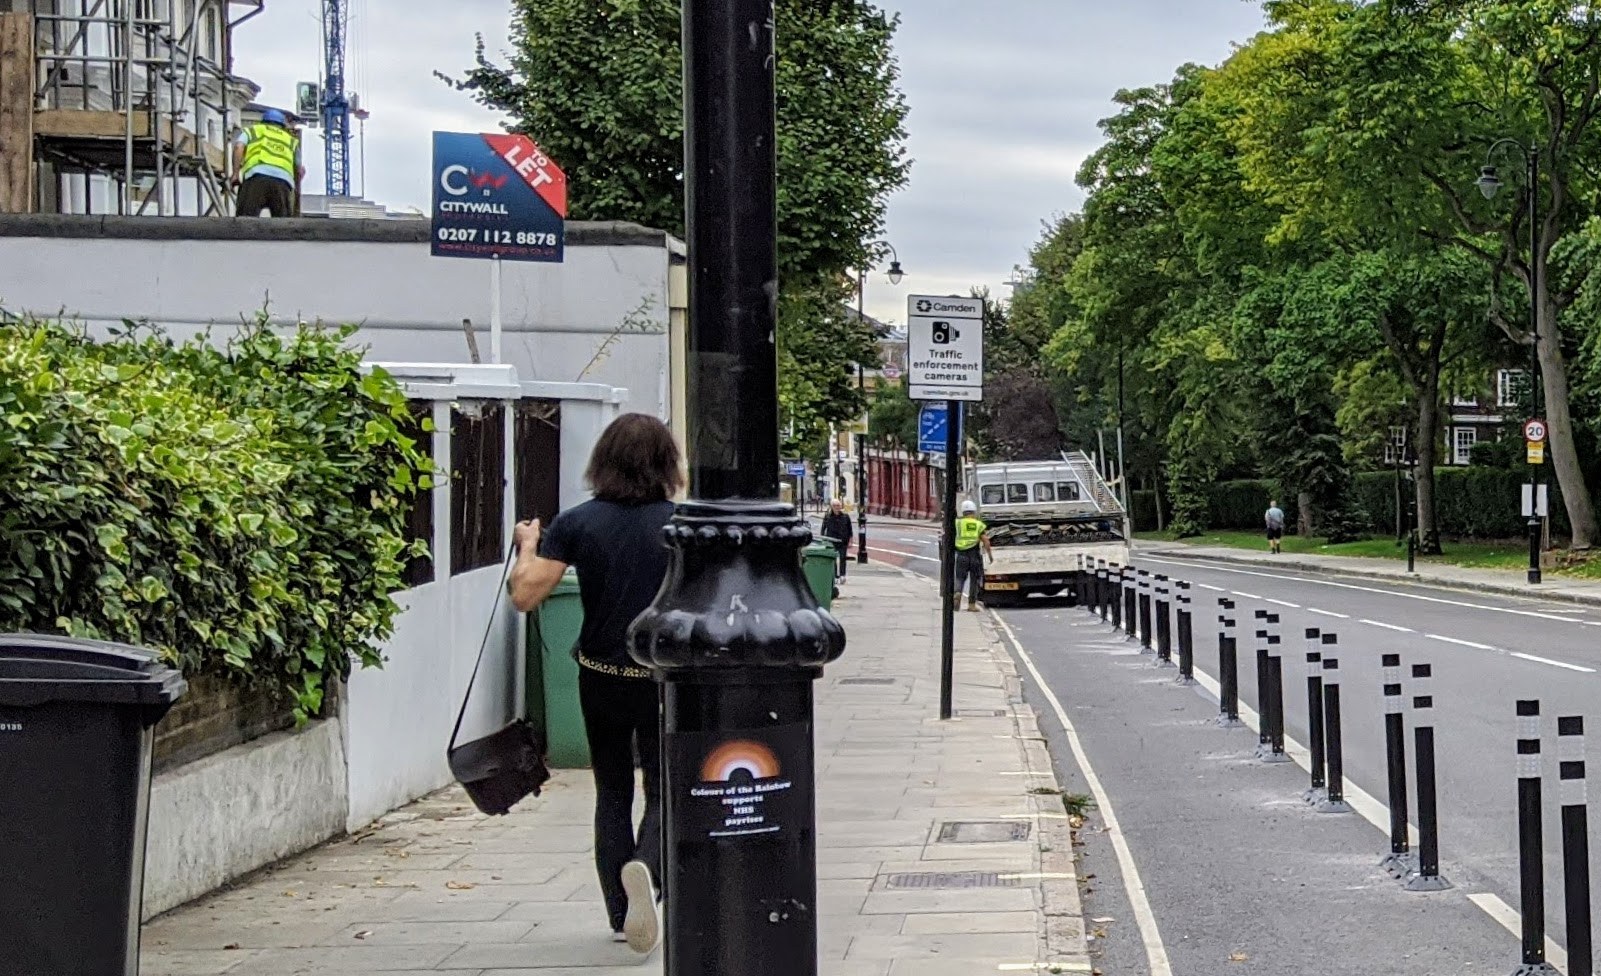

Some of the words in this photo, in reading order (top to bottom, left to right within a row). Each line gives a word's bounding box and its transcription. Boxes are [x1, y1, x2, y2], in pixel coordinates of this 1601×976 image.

[531, 149, 547, 167] TO
[504, 145, 553, 188] LET
[440, 201, 508, 214] CITYWALL
[438, 227, 477, 241] 0207
[484, 230, 511, 244] 112
[516, 231, 556, 246] 8878
[933, 302, 976, 313] Camden
[929, 349, 963, 360] Traffic
[913, 360, 979, 371] enforcement
[924, 373, 968, 381] cameras
[1528, 427, 1543, 436] 20
[691, 788, 724, 796] Colours
[725, 786, 736, 794] of
[737, 786, 754, 794] the
[755, 781, 791, 792] Rainbow
[722, 795, 764, 805] supports
[733, 806, 754, 814] NHS
[725, 816, 764, 826] payrises
